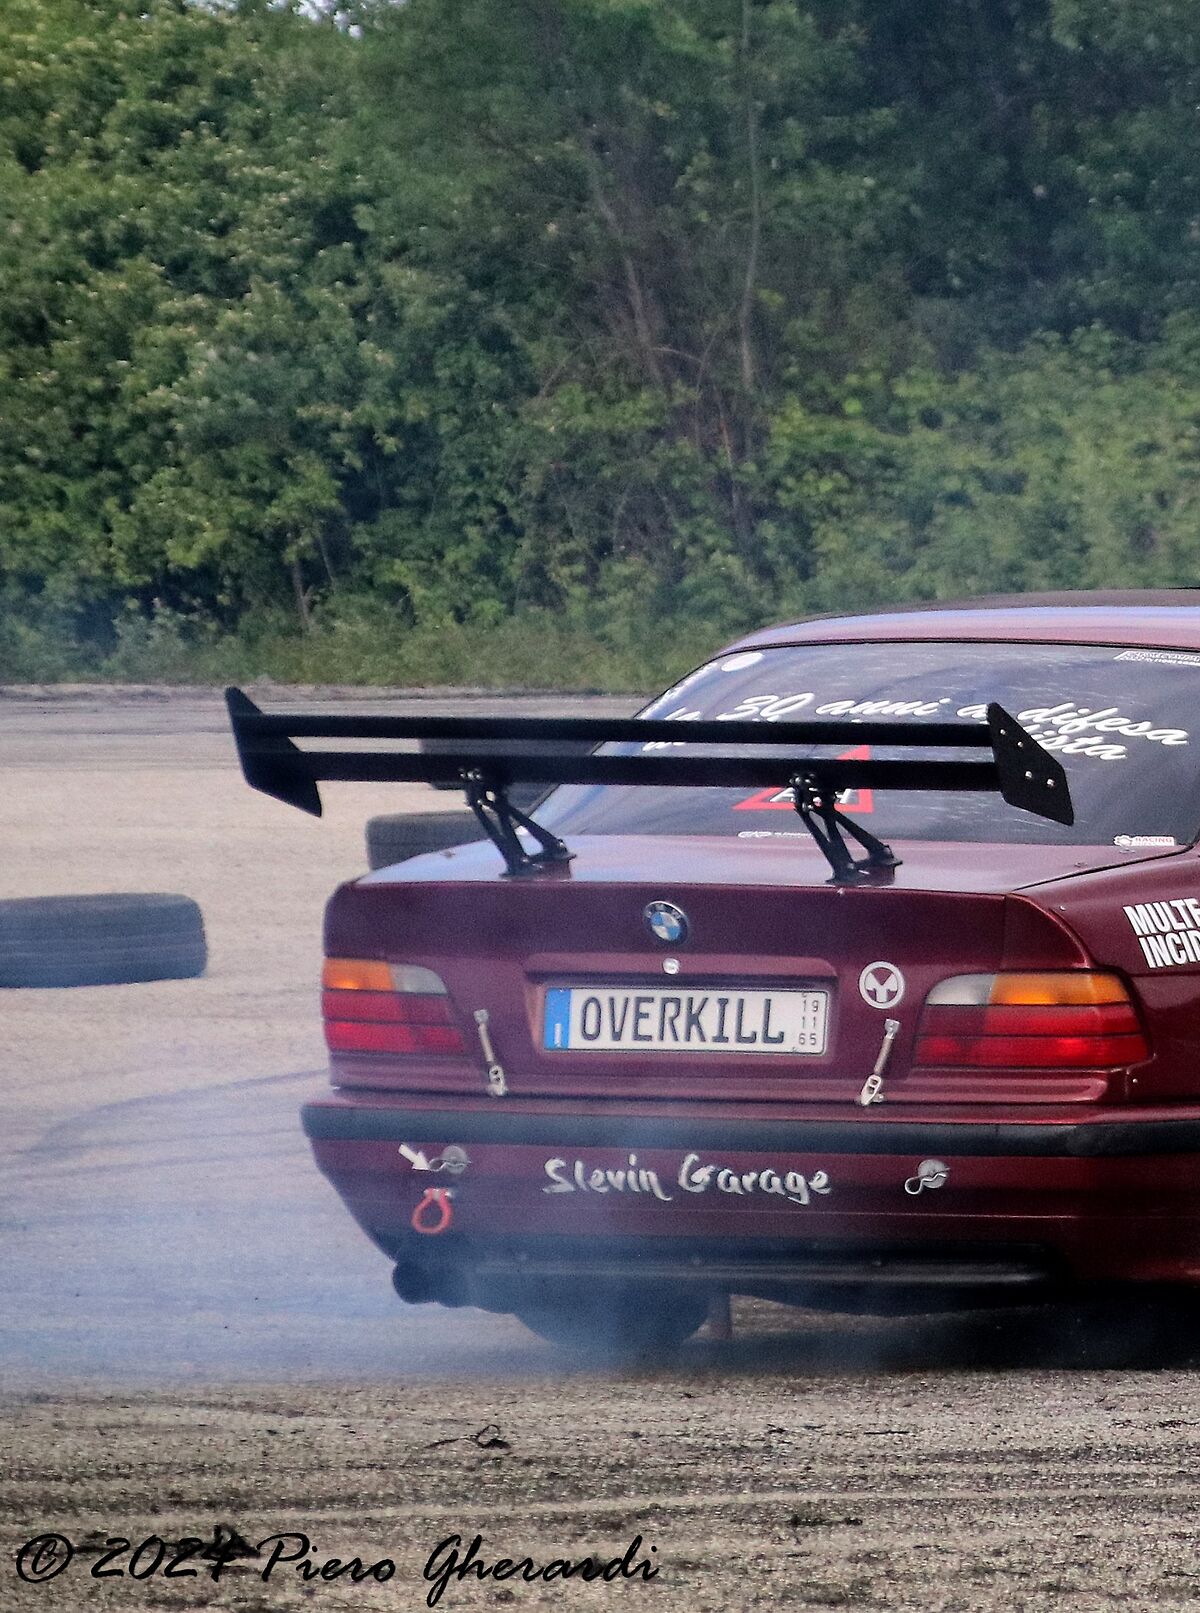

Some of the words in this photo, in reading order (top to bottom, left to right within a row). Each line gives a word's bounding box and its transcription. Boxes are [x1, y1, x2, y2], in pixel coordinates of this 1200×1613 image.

[716, 692, 815, 721] 30
[816, 697, 951, 716] anni
[1017, 702, 1188, 745] difesa
[580, 995, 785, 1044] OVERKILL
[801, 999, 820, 1013] 19
[801, 1016, 818, 1028] 11
[798, 1032, 818, 1046] 65
[542, 1153, 673, 1202] Slevin
[677, 1152, 832, 1206] Garage
